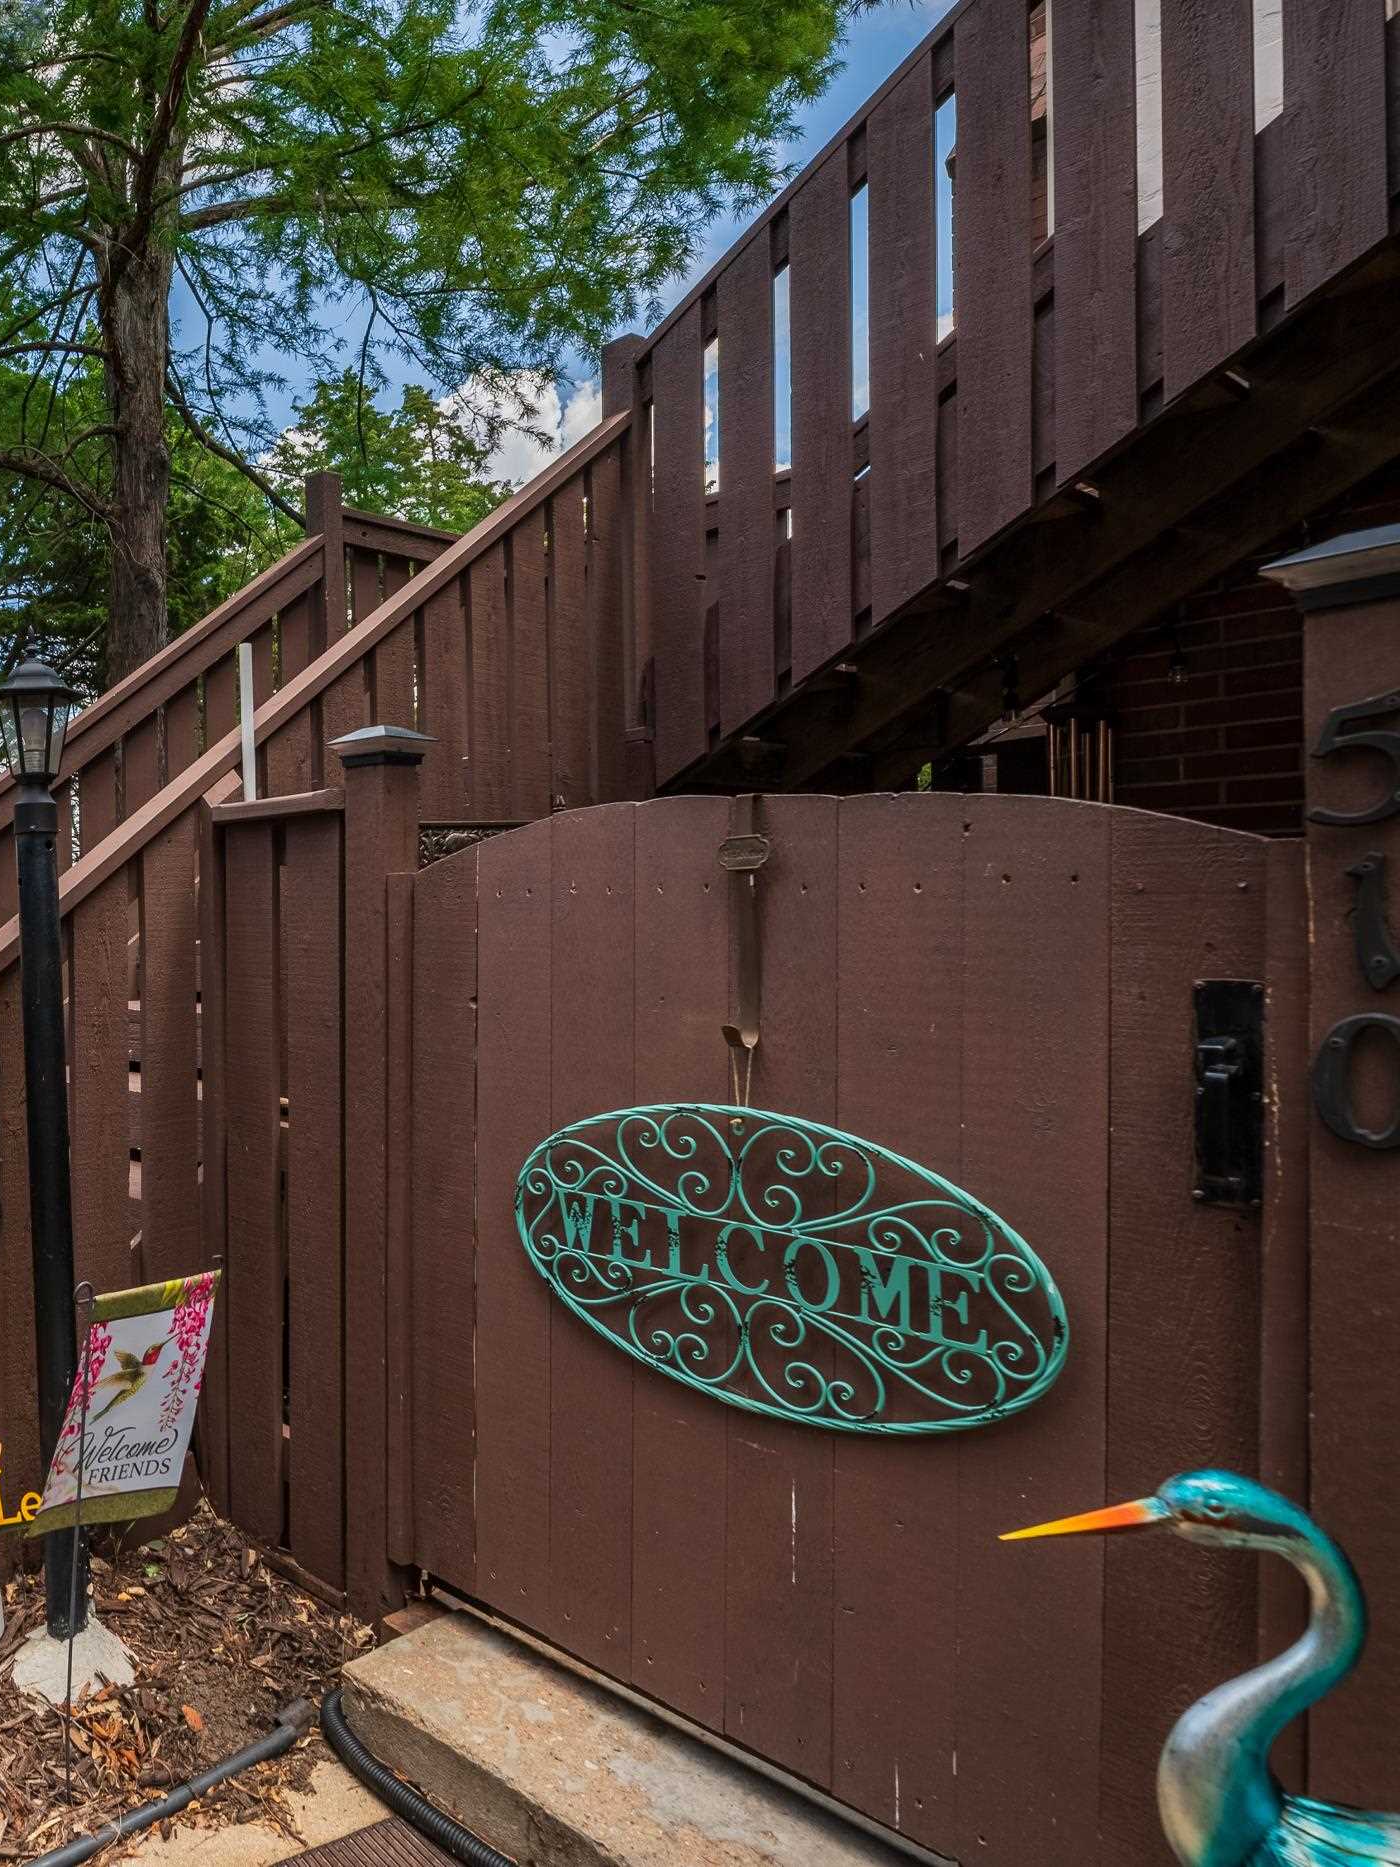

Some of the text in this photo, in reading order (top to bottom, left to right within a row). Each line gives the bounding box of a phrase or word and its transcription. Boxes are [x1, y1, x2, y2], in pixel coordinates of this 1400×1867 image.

[1306, 687, 1400, 1149] 510
[555, 1189, 991, 1355] WELCOME
[62, 1426, 178, 1473] Welcome
[88, 1457, 172, 1486] FRIENDS
